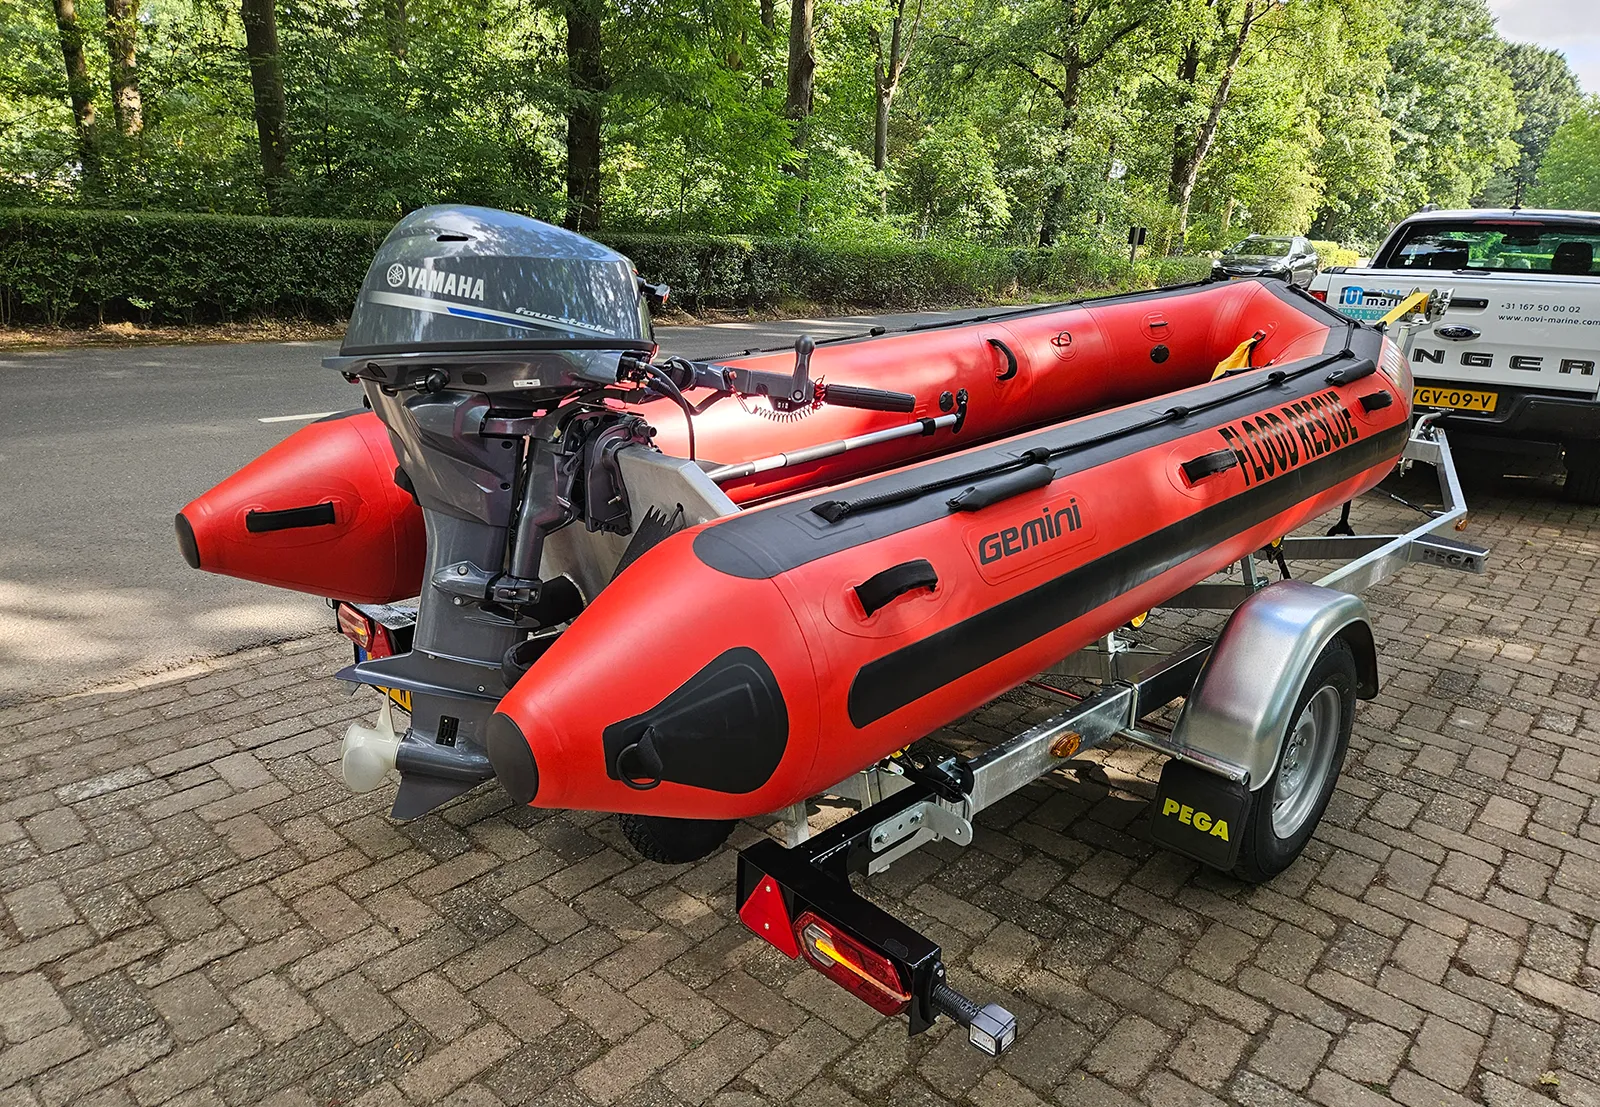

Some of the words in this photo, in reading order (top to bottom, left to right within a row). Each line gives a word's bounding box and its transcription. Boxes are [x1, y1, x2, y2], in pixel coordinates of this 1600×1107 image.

[405, 266, 484, 301] YAMAHA
[1498, 314, 1600, 326] www.novi-marine.com
[1501, 302, 1516, 310] +31
[1519, 303, 1535, 311] 167
[1537, 304, 1550, 312] 50
[1552, 305, 1566, 313] 00
[1412, 348, 1596, 376] NGER
[1218, 411, 1300, 487] FLOOD
[1281, 390, 1359, 460] RESCUE
[1422, 548, 1476, 570] PEGA
[1162, 797, 1229, 842] PEGA
